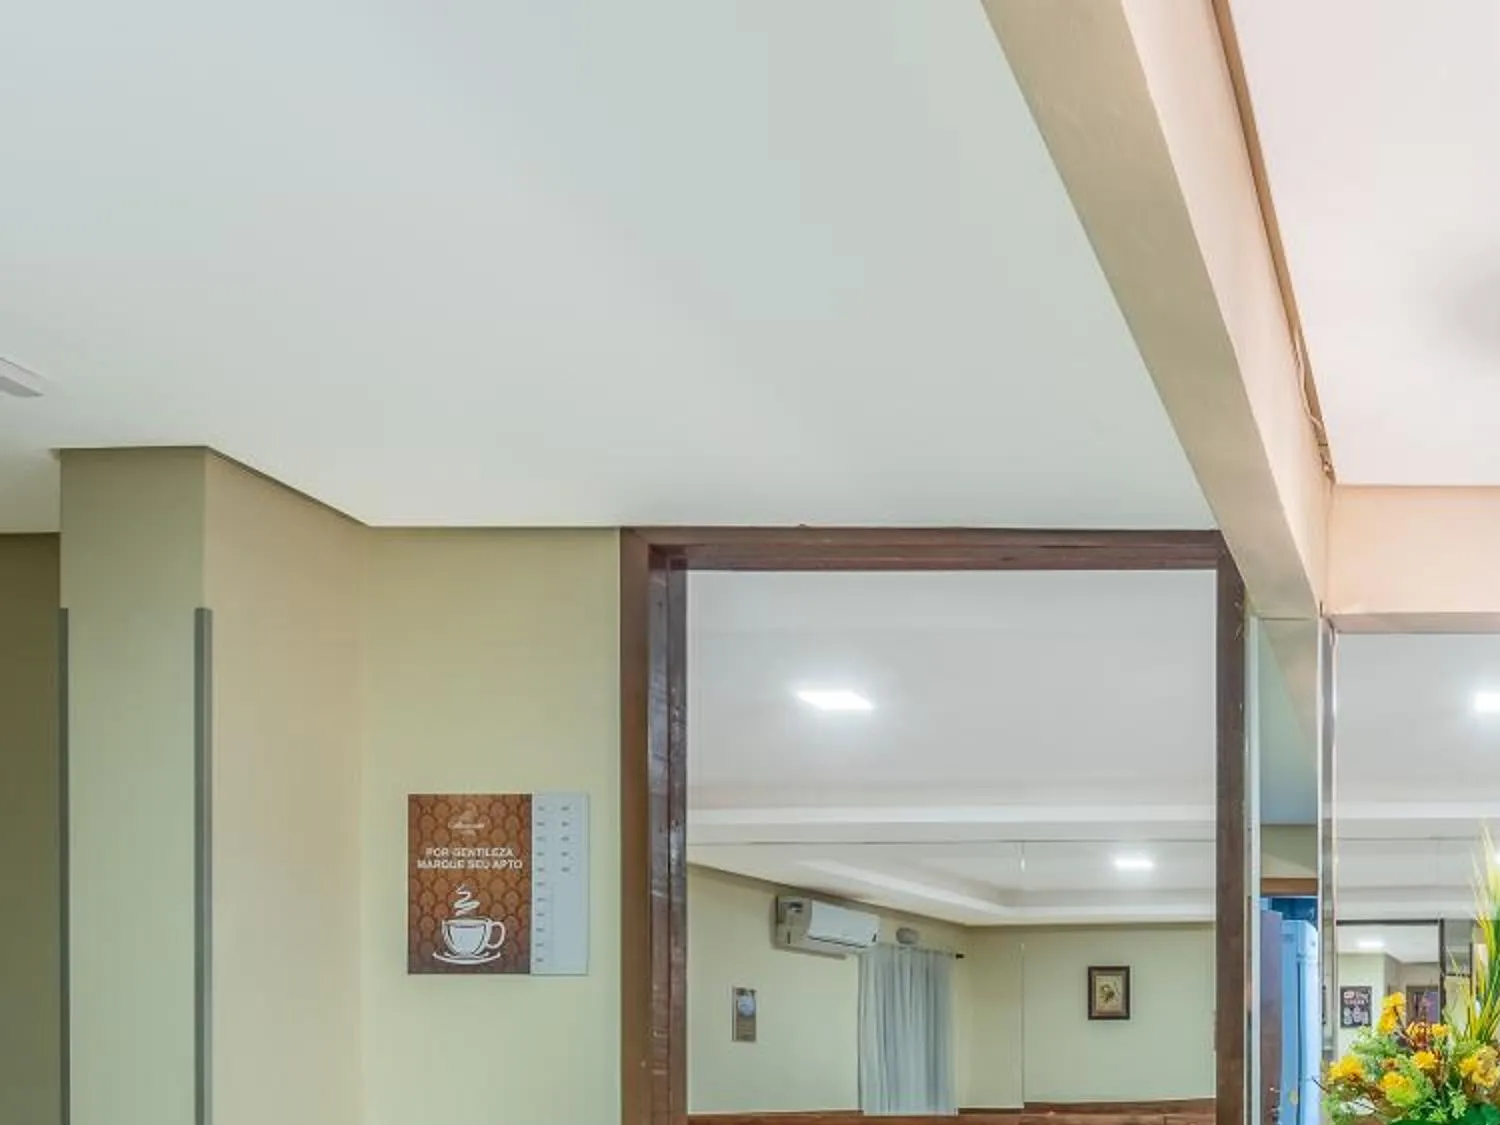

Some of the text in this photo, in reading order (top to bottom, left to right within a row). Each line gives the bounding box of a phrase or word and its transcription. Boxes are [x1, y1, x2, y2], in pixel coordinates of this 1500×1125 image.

[425, 847, 514, 857] POR GENTILEZA
[417, 860, 523, 869] MARQUE SEU APTO
